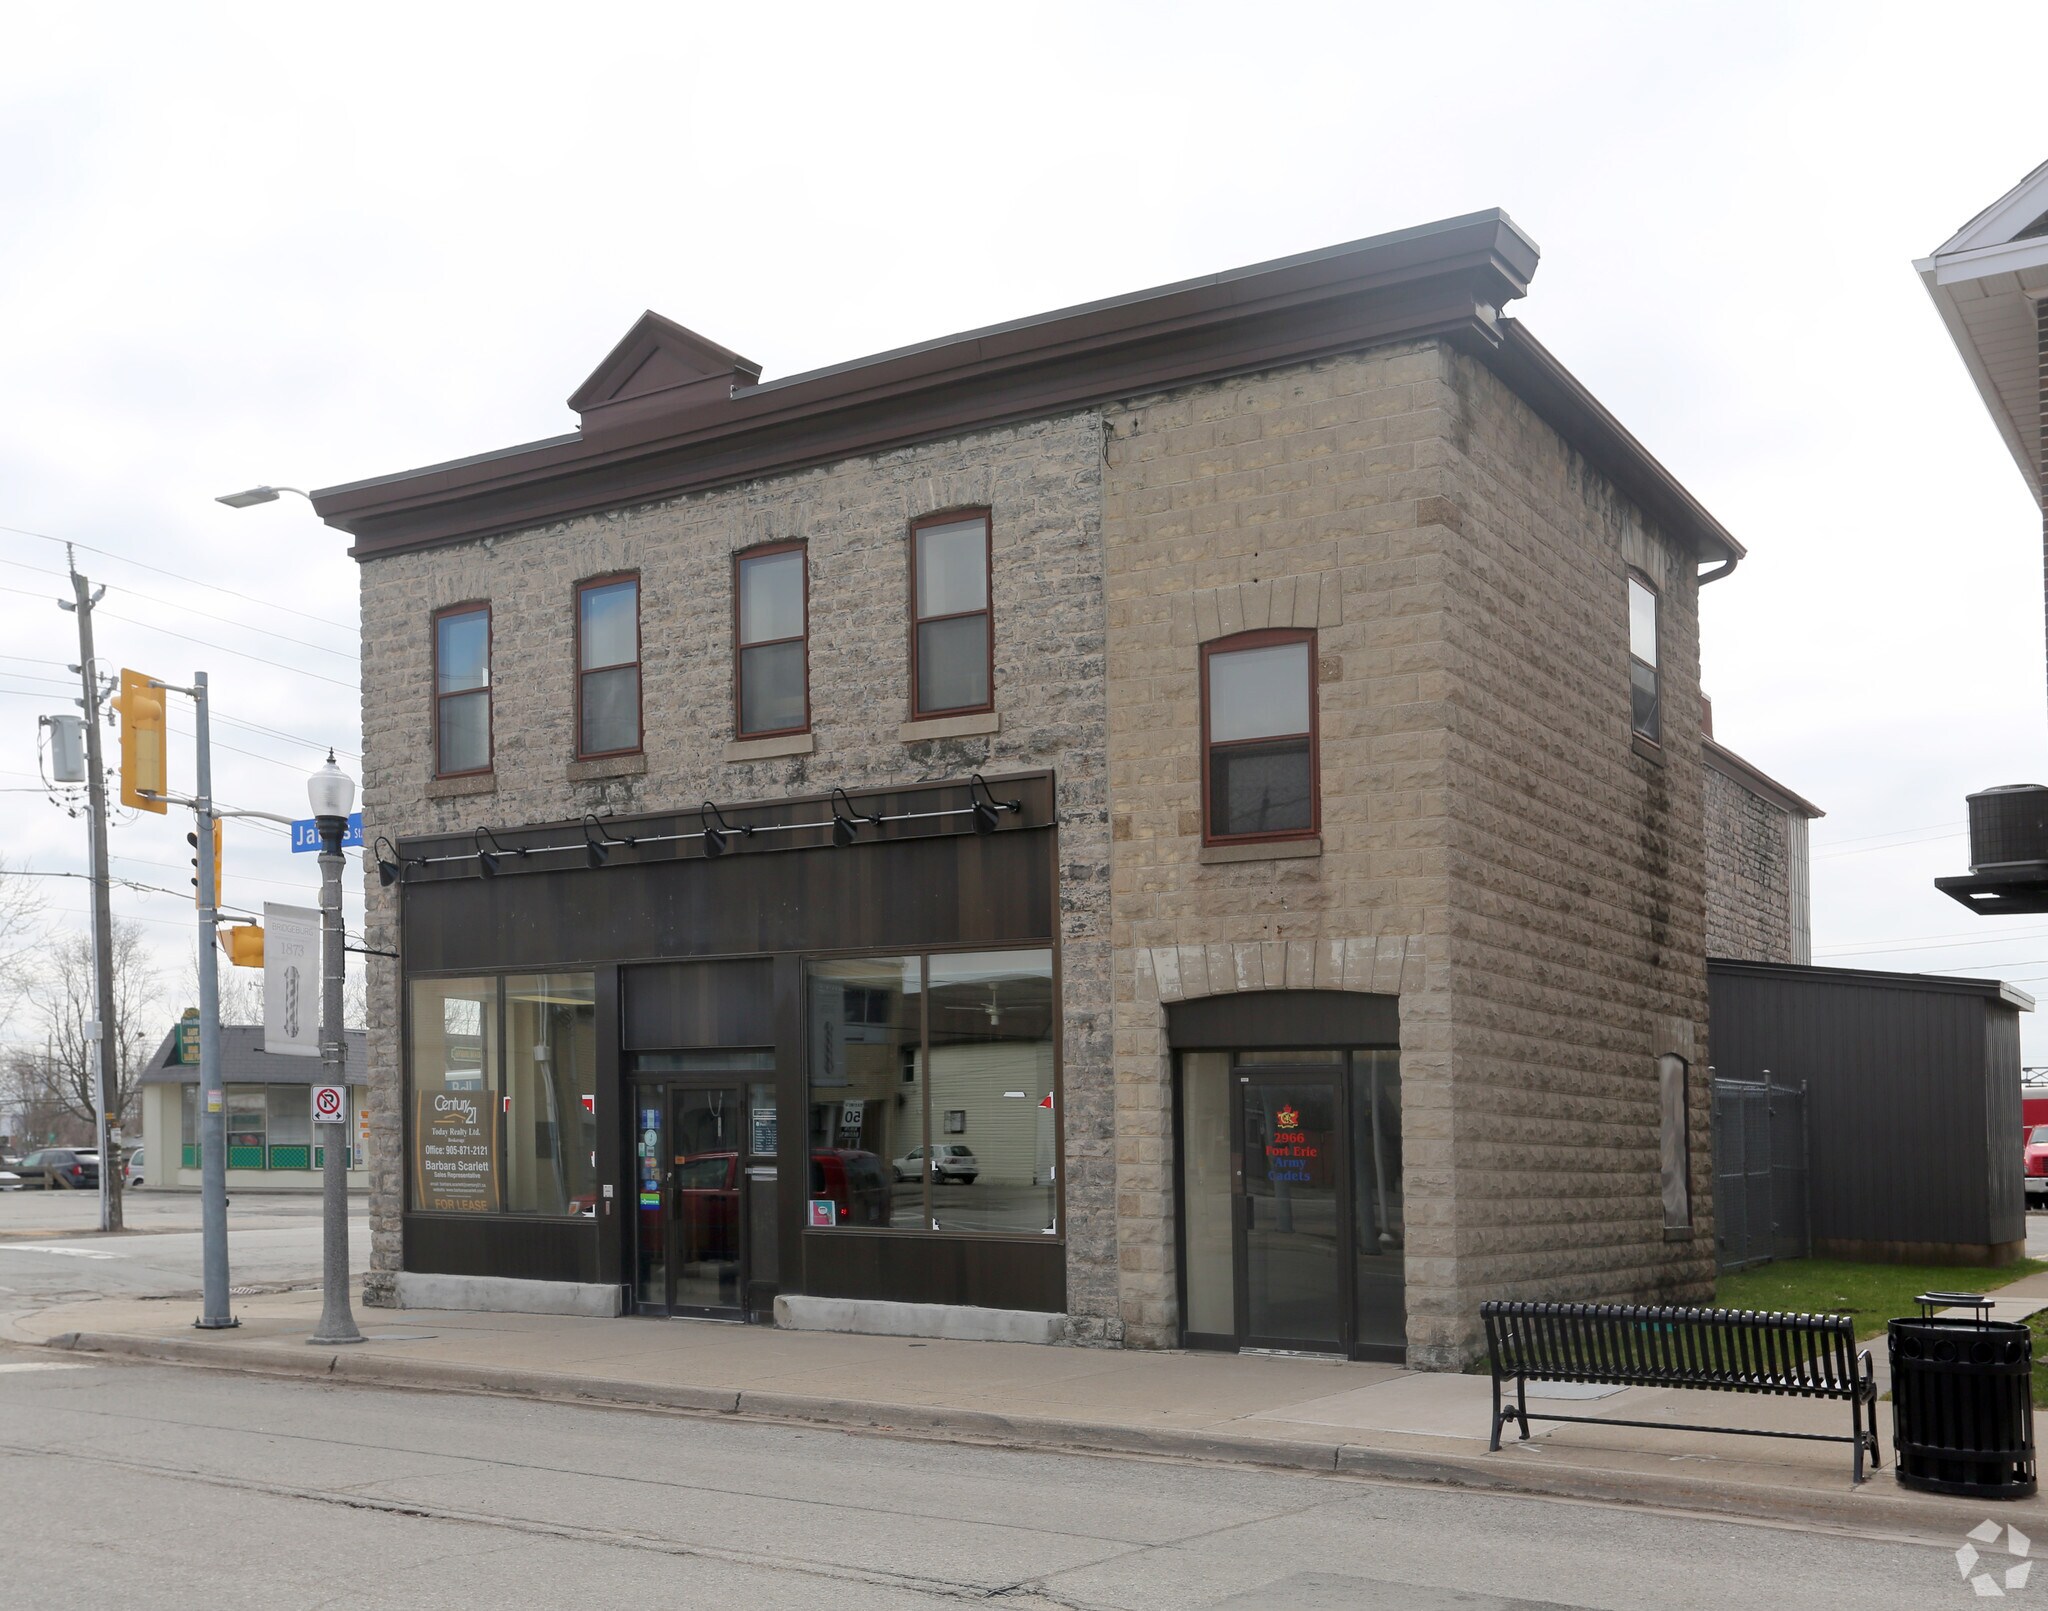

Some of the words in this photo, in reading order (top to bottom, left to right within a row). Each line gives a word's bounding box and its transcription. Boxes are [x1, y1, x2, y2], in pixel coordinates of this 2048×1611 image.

[272, 922, 313, 936] BRIDGEBURG
[281, 942, 304, 957] 1873
[434, 1095, 470, 1113] Century
[465, 1107, 476, 1124] 21
[432, 1128, 448, 1137] Today
[449, 1128, 467, 1137] Realty
[469, 1128, 480, 1136] Ltd.
[1274, 1132, 1305, 1143] 2966
[425, 1145, 444, 1155] Office:
[446, 1145, 488, 1156] 905-871-2121
[1265, 1145, 1290, 1156] Fort
[1293, 1146, 1317, 1157] Erie
[425, 1161, 456, 1171] Barbara
[458, 1161, 488, 1171] Scarlett
[1276, 1157, 1305, 1170] Army
[1267, 1170, 1311, 1182] Cadets
[435, 1199, 455, 1210] FOR
[456, 1199, 488, 1211] LEASE
